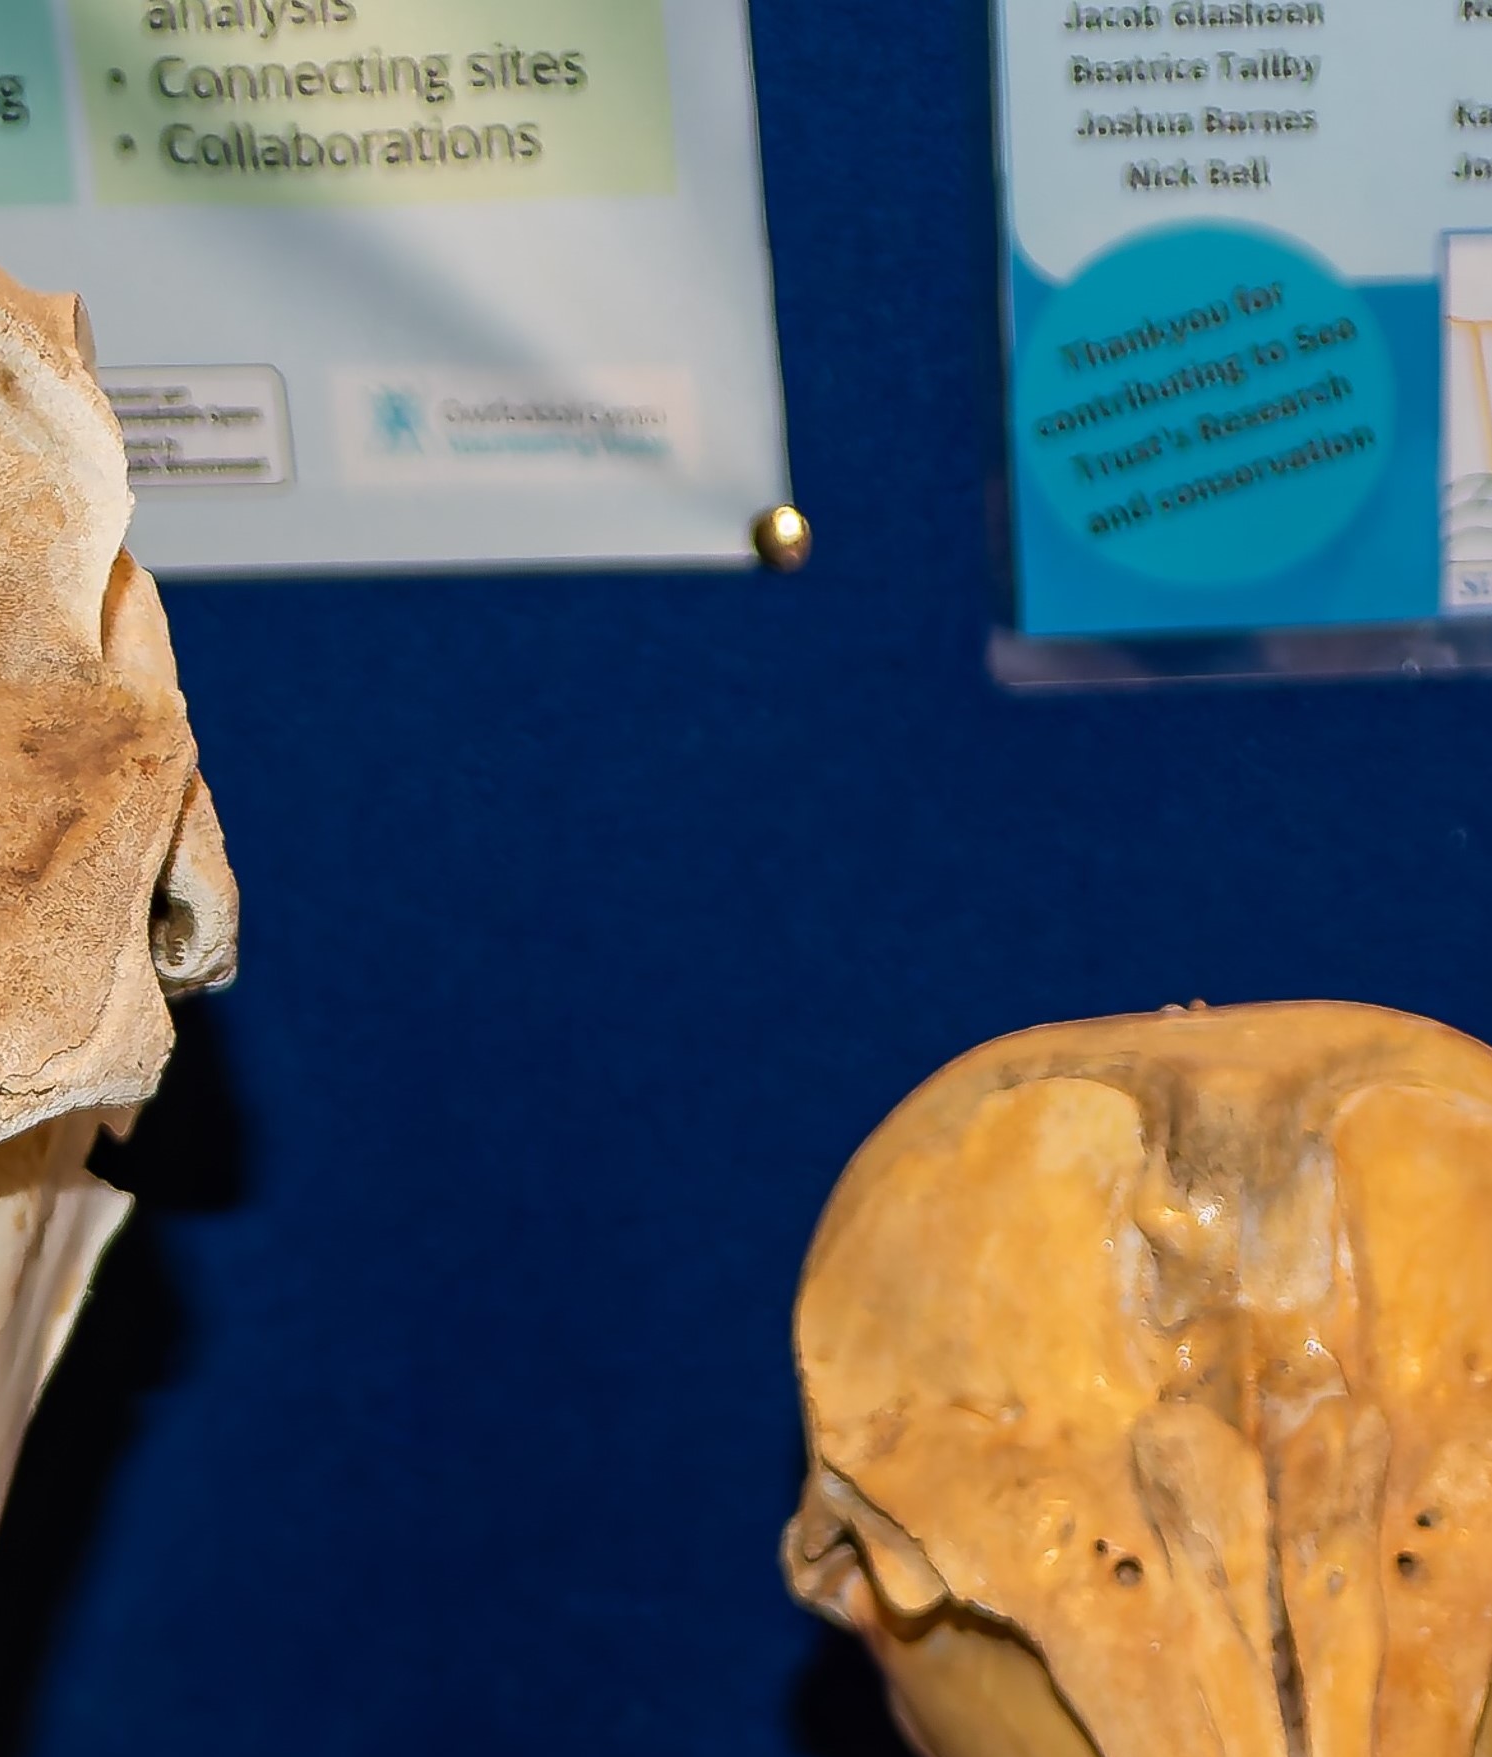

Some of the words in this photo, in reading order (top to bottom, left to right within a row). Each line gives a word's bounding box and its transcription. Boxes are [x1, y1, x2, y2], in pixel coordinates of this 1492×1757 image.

[155, 48, 452, 103] Connecting
[465, 42, 587, 87] sites
[163, 116, 542, 170] Collaborations
[1125, 157, 1198, 190] Nick
